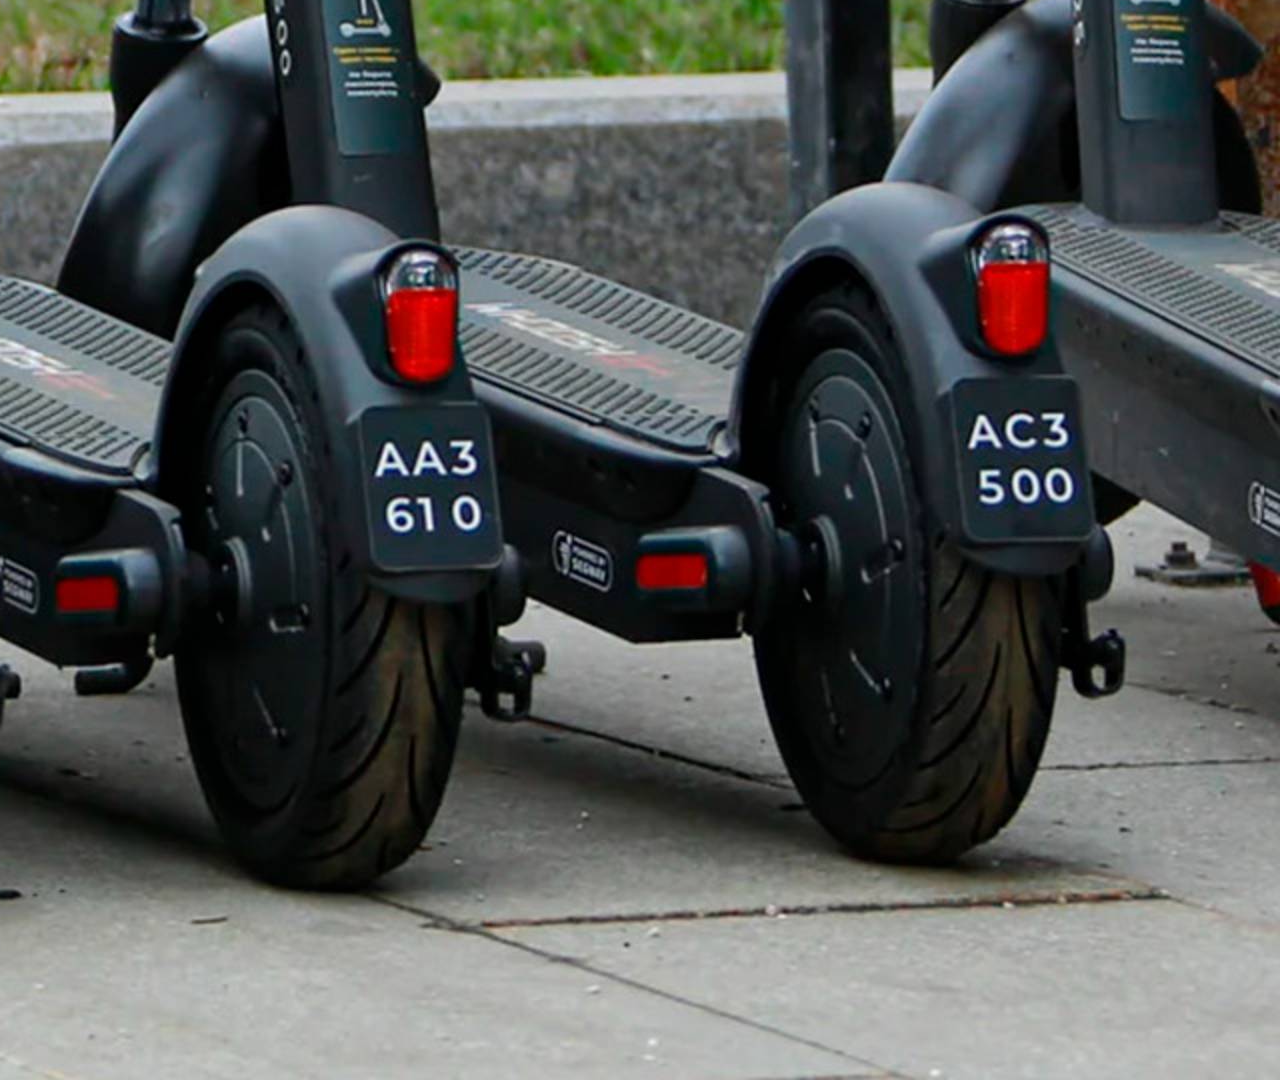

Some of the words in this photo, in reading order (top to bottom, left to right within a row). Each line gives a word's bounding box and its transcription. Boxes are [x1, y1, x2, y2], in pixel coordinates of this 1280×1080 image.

[967, 413, 1070, 449] AC3
[374, 440, 479, 478] AA3
[977, 468, 1074, 505] 500
[385, 495, 482, 533] 610
